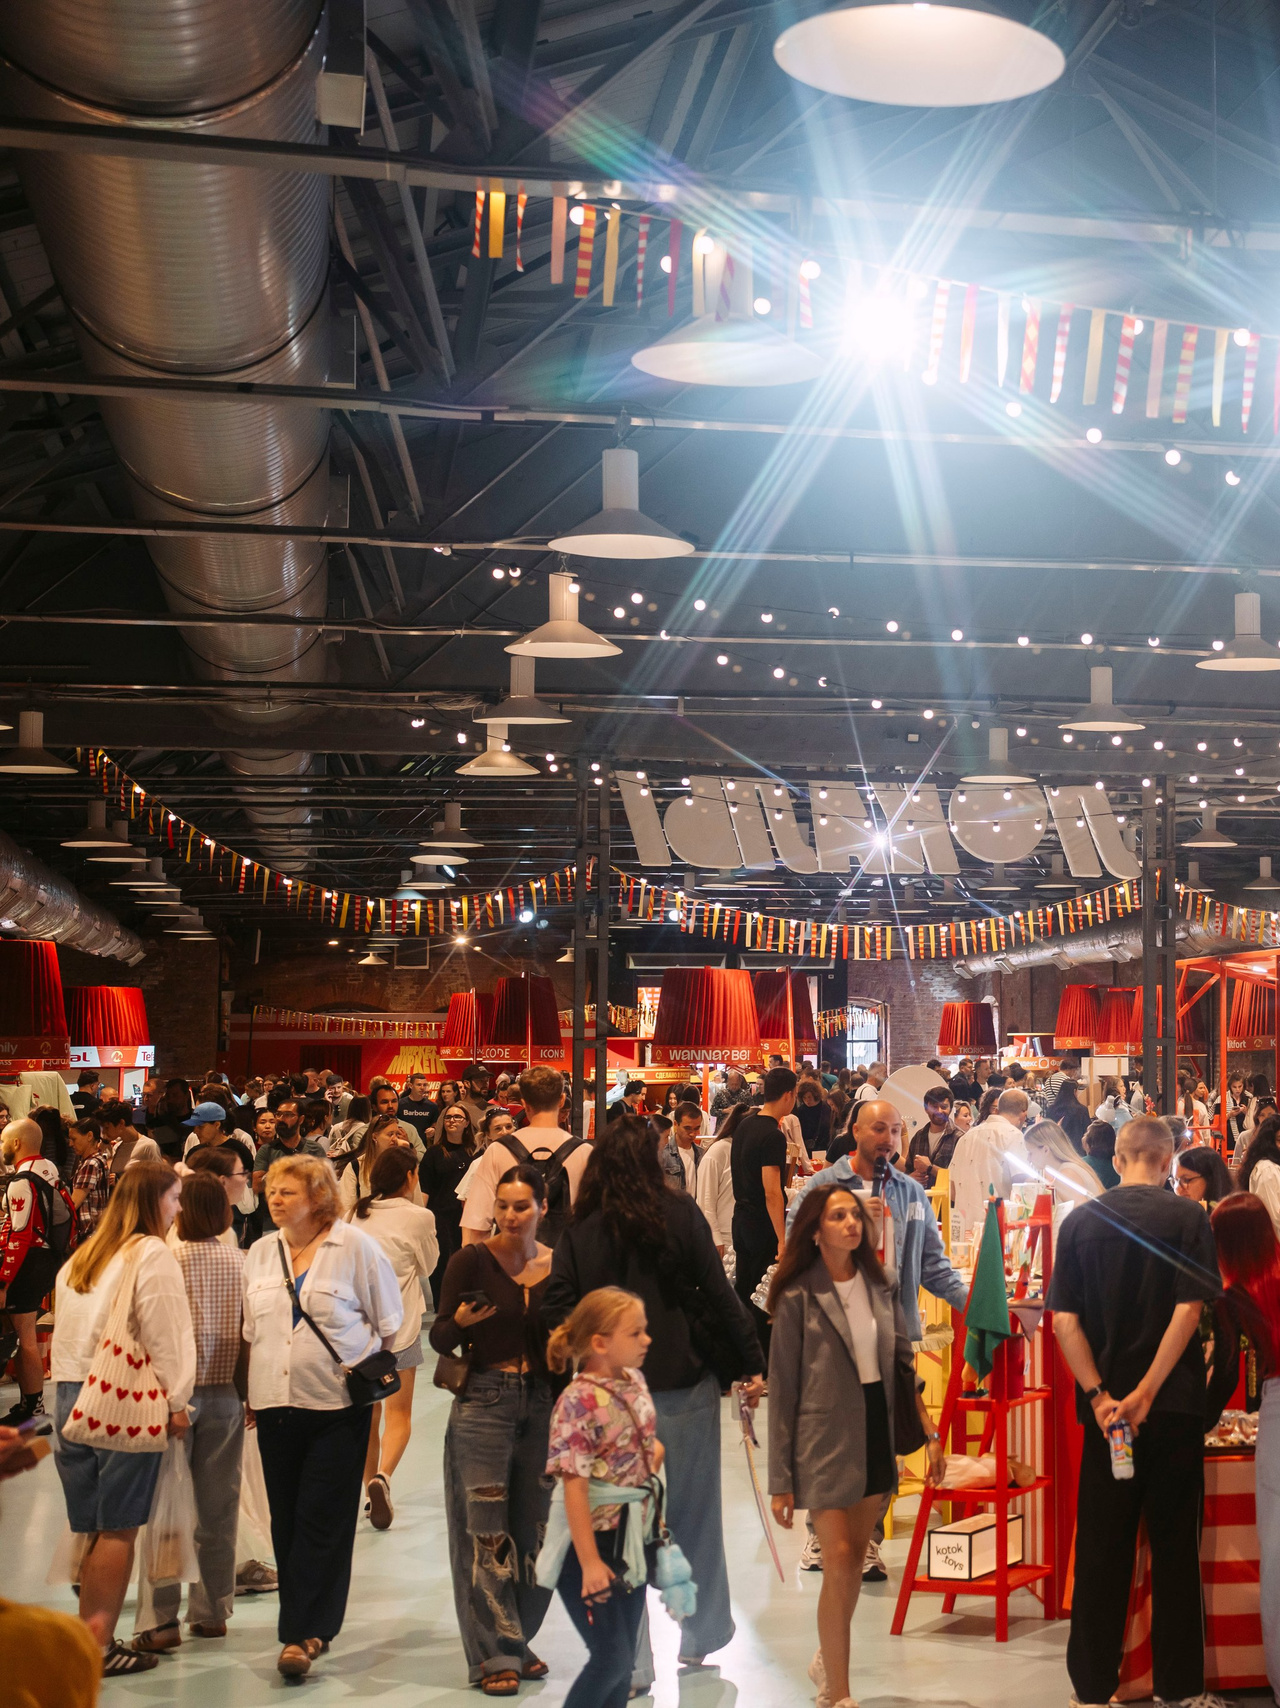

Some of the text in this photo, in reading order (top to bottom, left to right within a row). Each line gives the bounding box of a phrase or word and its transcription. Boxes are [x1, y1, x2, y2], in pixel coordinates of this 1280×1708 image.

[482, 1048, 511, 1059] CODE
[540, 1048, 560, 1059] ICON
[403, 1109, 430, 1117] Barbour
[935, 1542, 963, 1556] kotok
